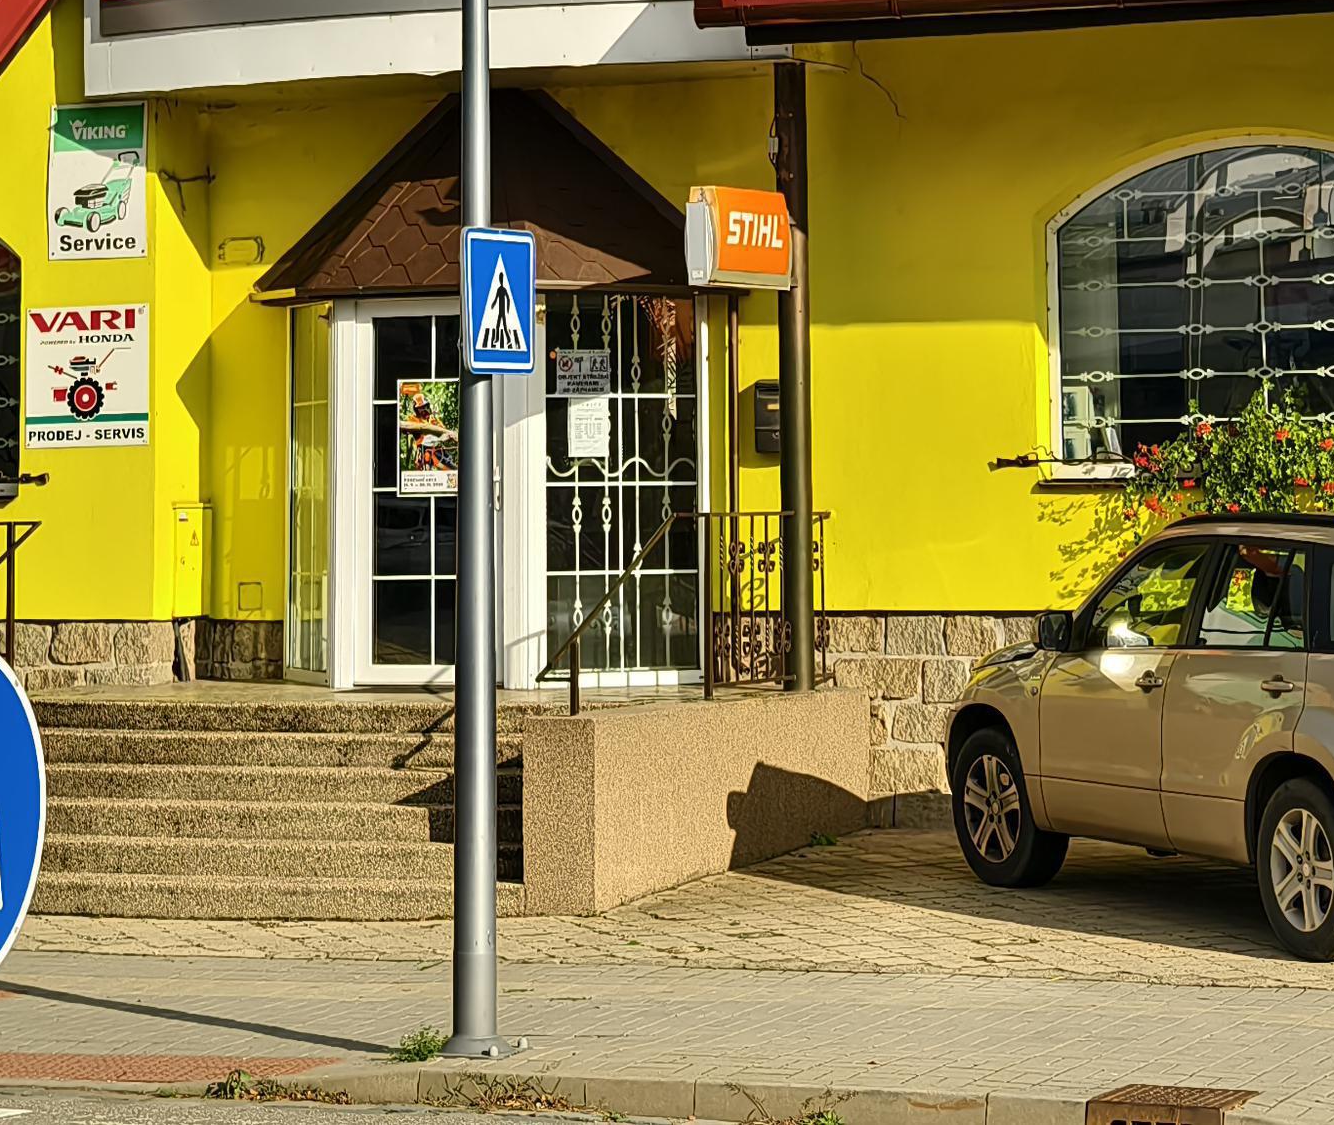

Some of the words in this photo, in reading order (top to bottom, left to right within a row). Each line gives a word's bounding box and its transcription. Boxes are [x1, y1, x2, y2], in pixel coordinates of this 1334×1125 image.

[72, 123, 127, 141] VIKING
[726, 210, 784, 249] STIHL
[59, 233, 137, 252] Service
[29, 308, 136, 333] VARI
[78, 333, 135, 344] HONDA
[28, 430, 82, 442] PRODEJ
[94, 427, 145, 440] SERVIS
